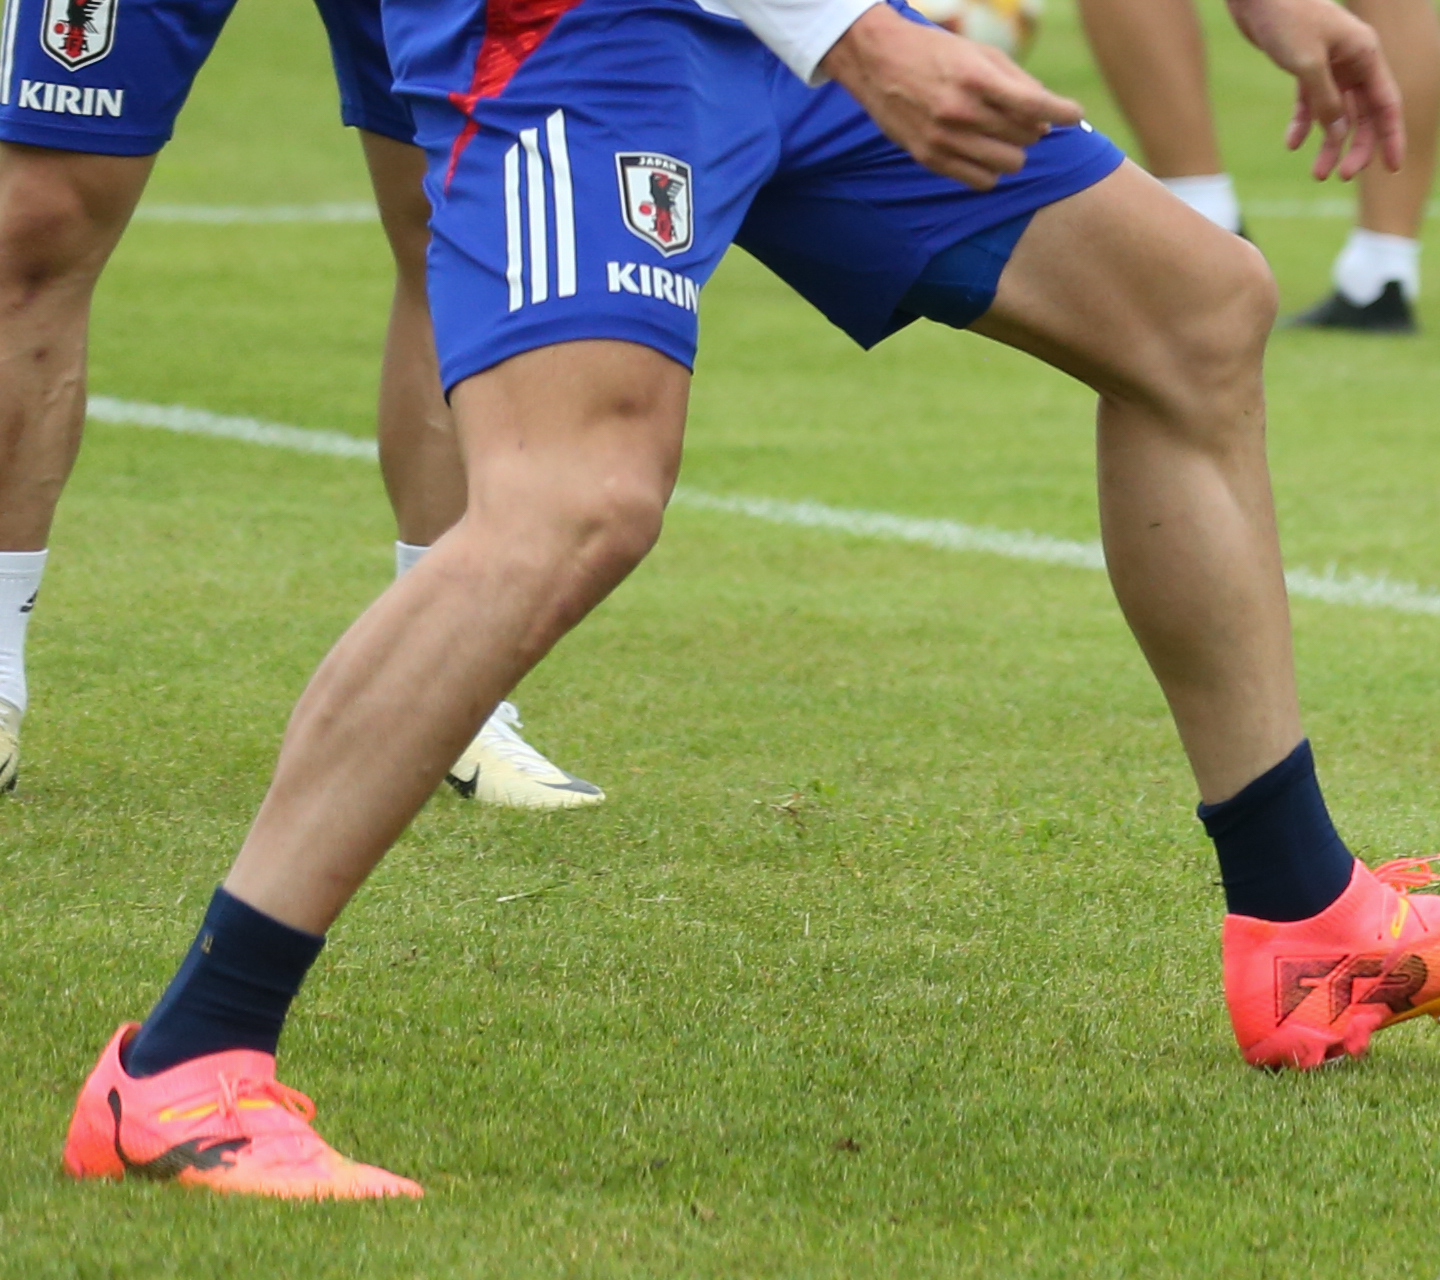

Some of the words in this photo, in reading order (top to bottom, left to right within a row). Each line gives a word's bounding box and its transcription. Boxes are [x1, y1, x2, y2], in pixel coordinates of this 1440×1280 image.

[18, 79, 123, 117] KIRIN
[639, 156, 677, 172] JAPAN
[607, 261, 699, 314] KIRIN
